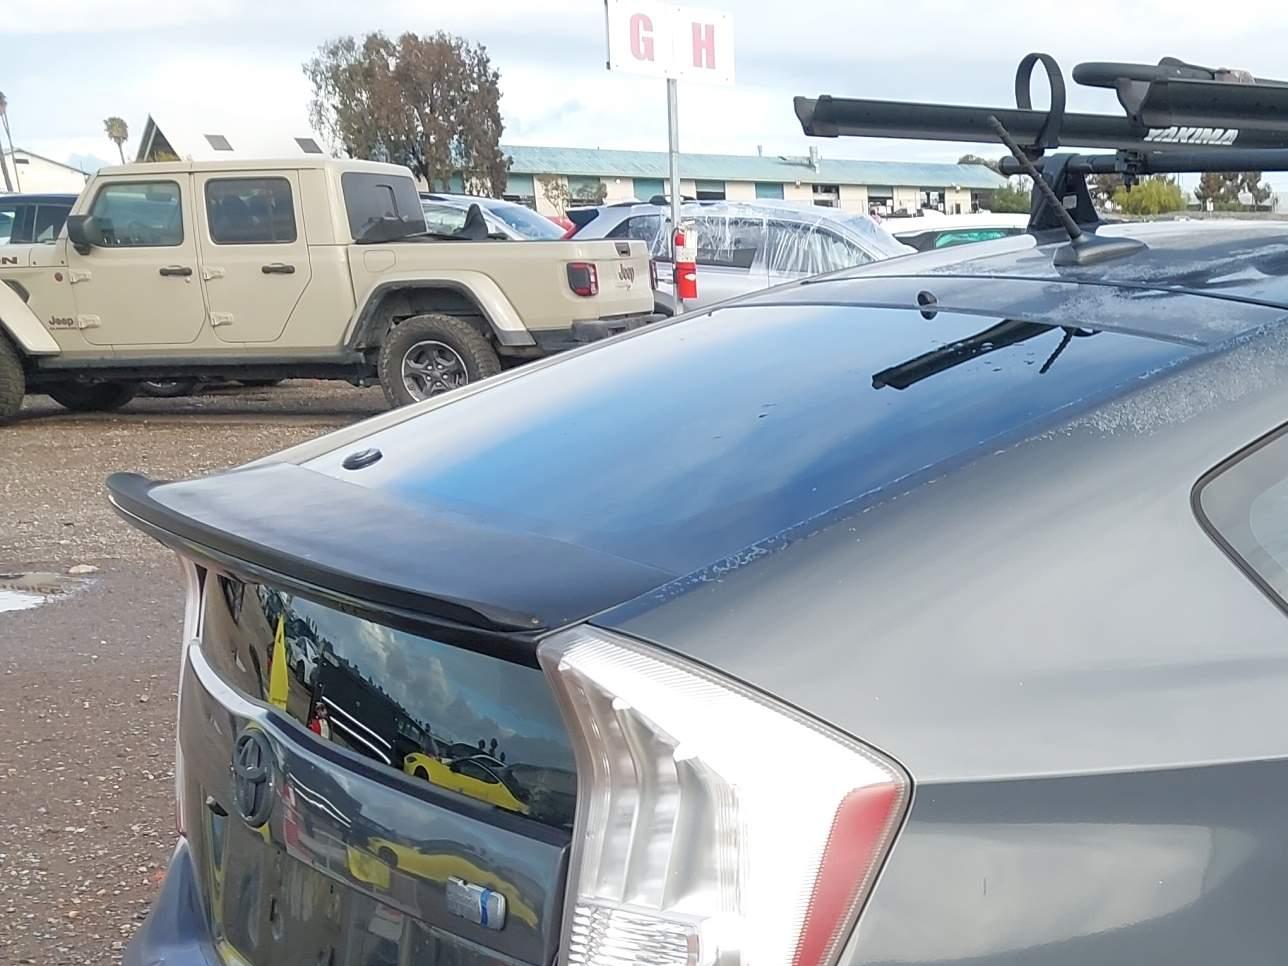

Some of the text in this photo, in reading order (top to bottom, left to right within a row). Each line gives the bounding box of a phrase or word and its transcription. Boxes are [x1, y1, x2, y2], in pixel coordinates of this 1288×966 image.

[629, 12, 655, 62] G
[691, 21, 716, 70] H
[1143, 126, 1239, 146] YAKIMA
[49, 316, 74, 327] Jeep
